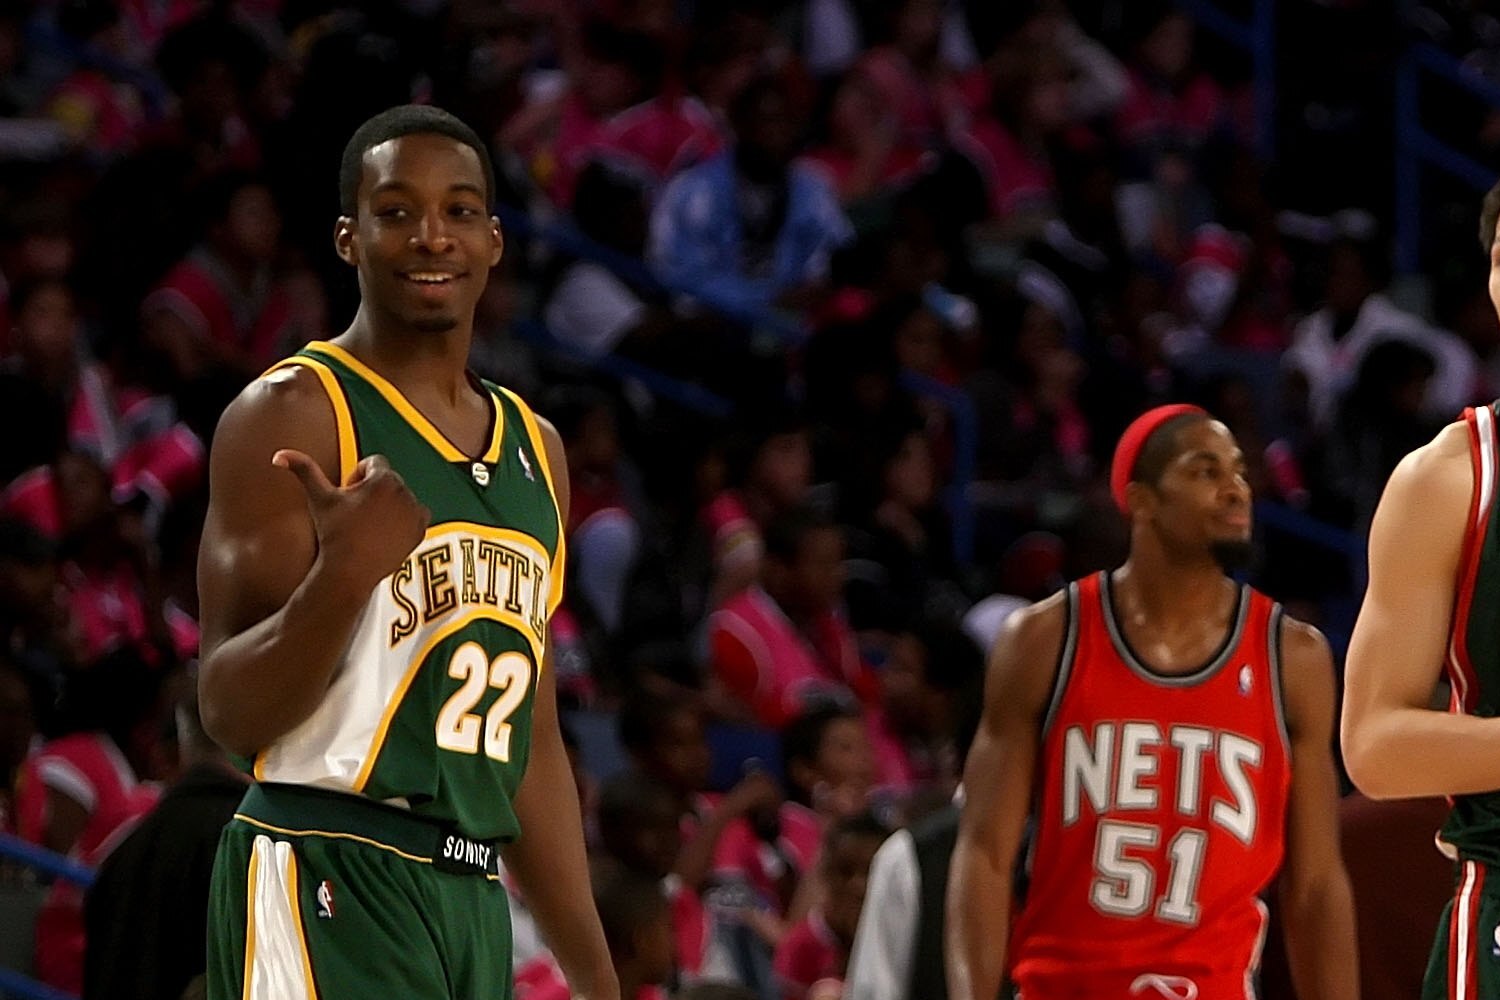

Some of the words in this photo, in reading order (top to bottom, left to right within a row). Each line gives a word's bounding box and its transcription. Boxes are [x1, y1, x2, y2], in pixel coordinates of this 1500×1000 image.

[390, 539, 547, 648] SEATTL
[434, 640, 532, 764] 22
[1060, 719, 1265, 848] NETS
[1089, 818, 1209, 928] 51
